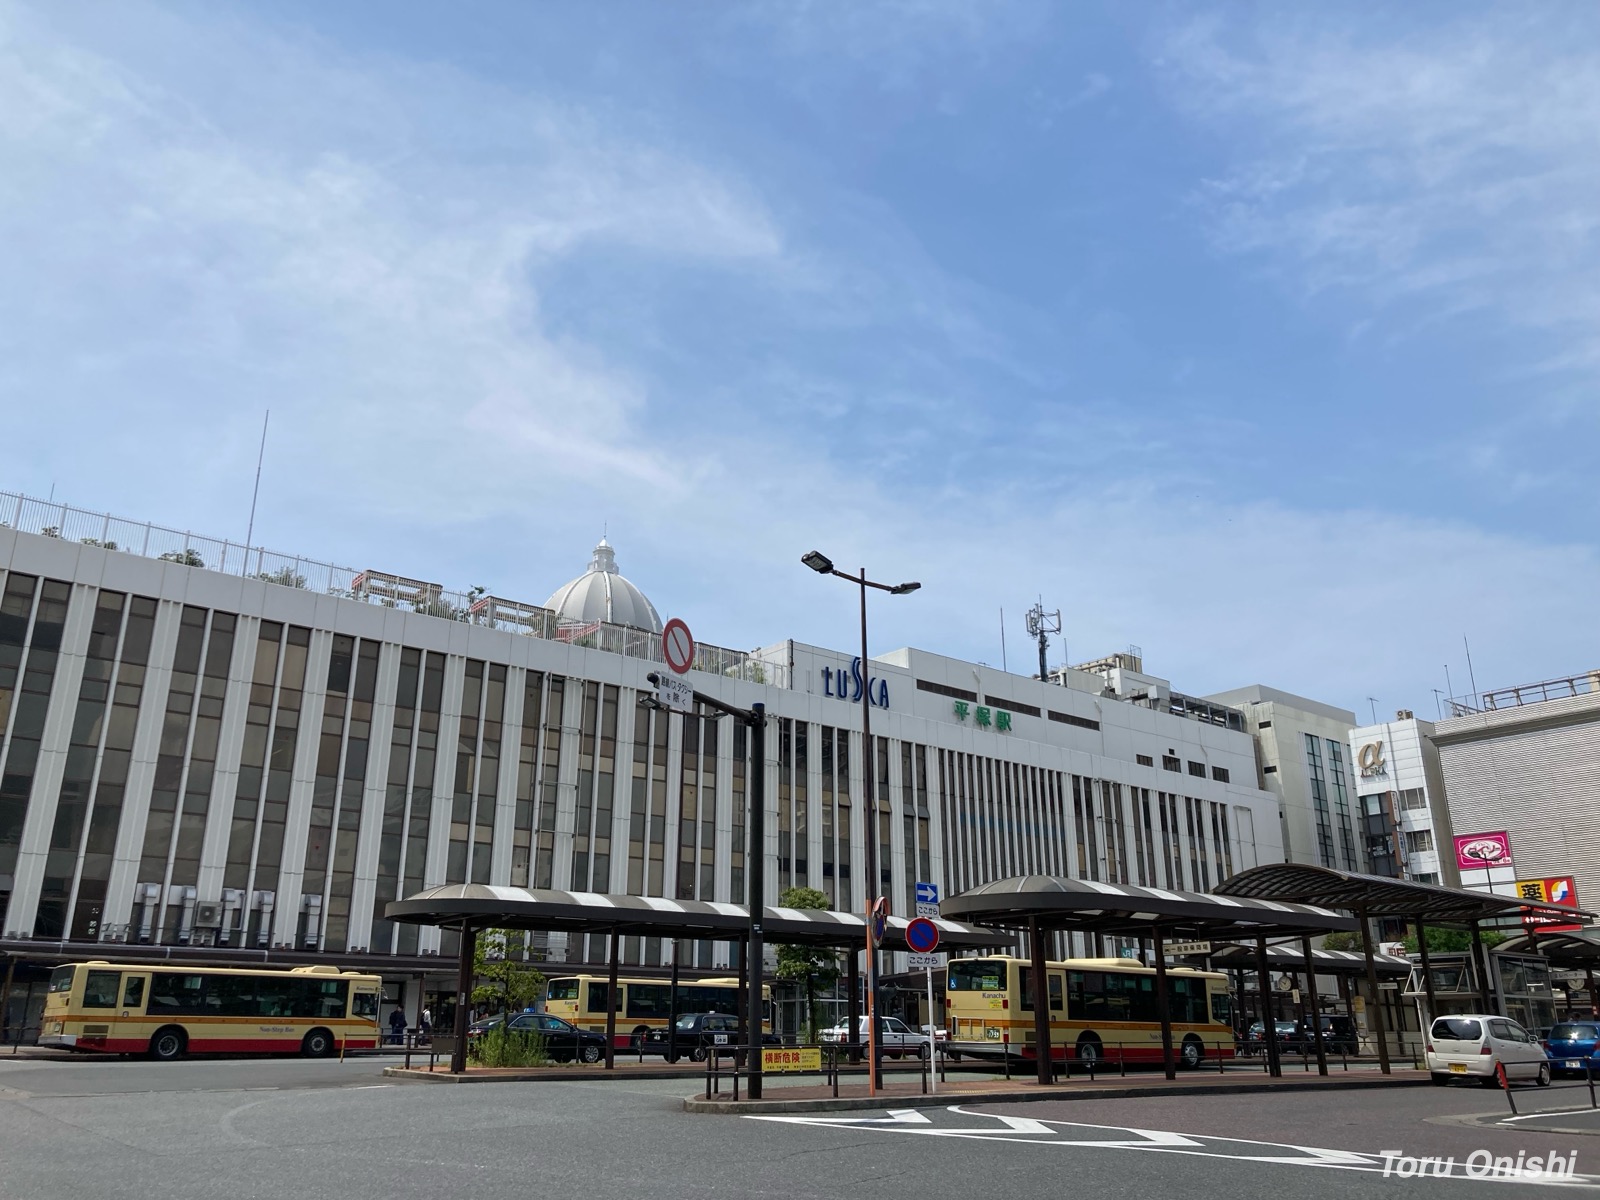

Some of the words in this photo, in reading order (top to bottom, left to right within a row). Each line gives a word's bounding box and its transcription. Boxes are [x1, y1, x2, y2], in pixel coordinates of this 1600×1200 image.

[824, 656, 890, 709] LUSCA
[954, 700, 1012, 732] 平塚駅
[1521, 883, 1544, 902] 薬
[918, 906, 938, 915] ここから
[909, 956, 938, 964] ここから
[1122, 950, 1132, 958] JR
[765, 1052, 800, 1064] 横断危険
